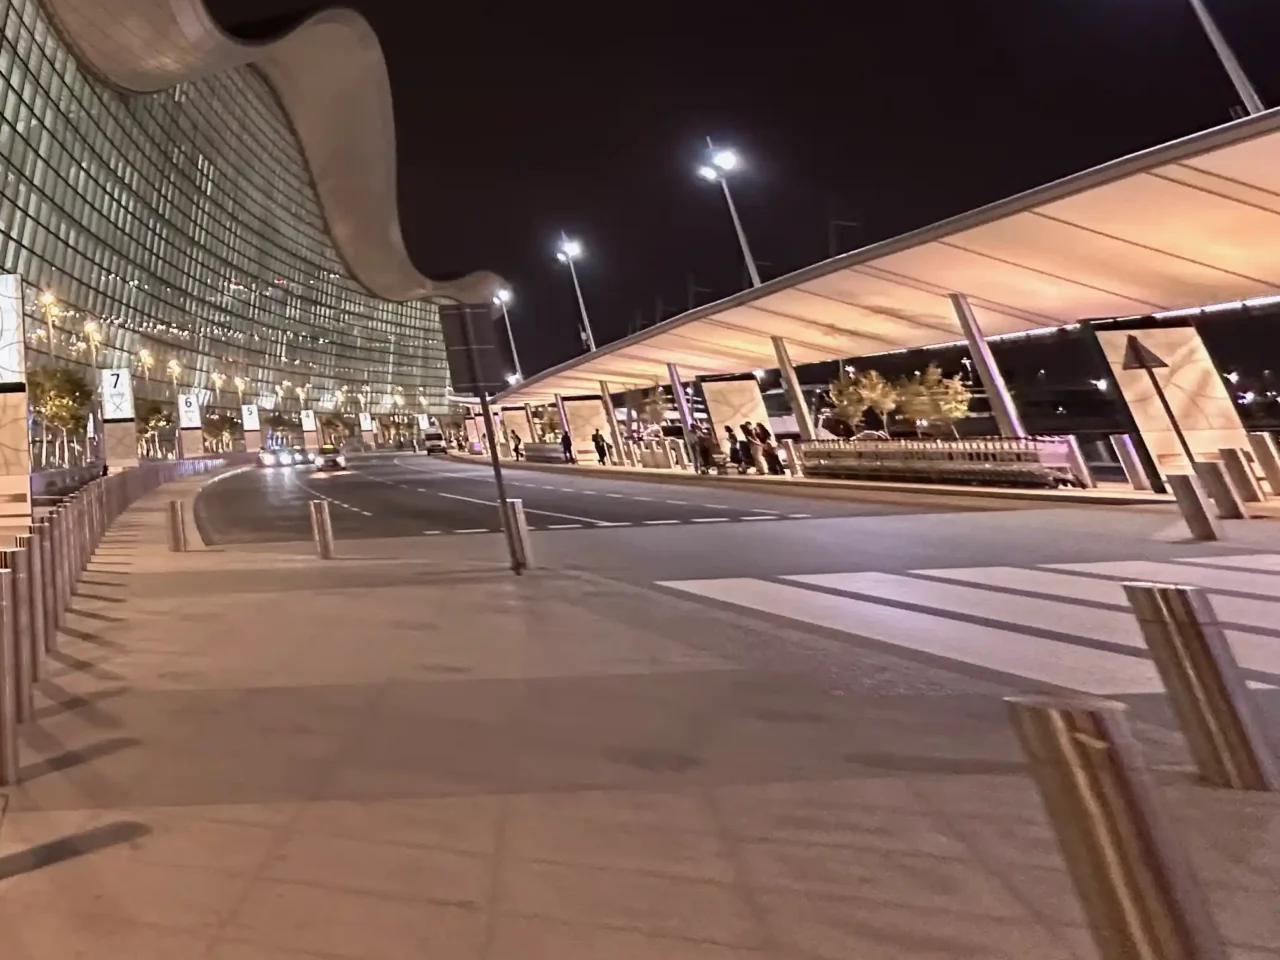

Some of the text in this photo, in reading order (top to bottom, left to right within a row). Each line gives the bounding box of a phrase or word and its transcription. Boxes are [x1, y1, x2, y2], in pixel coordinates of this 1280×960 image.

[110, 373, 120, 389] 7
[184, 397, 193, 408] 6
[246, 406, 253, 416] 5
